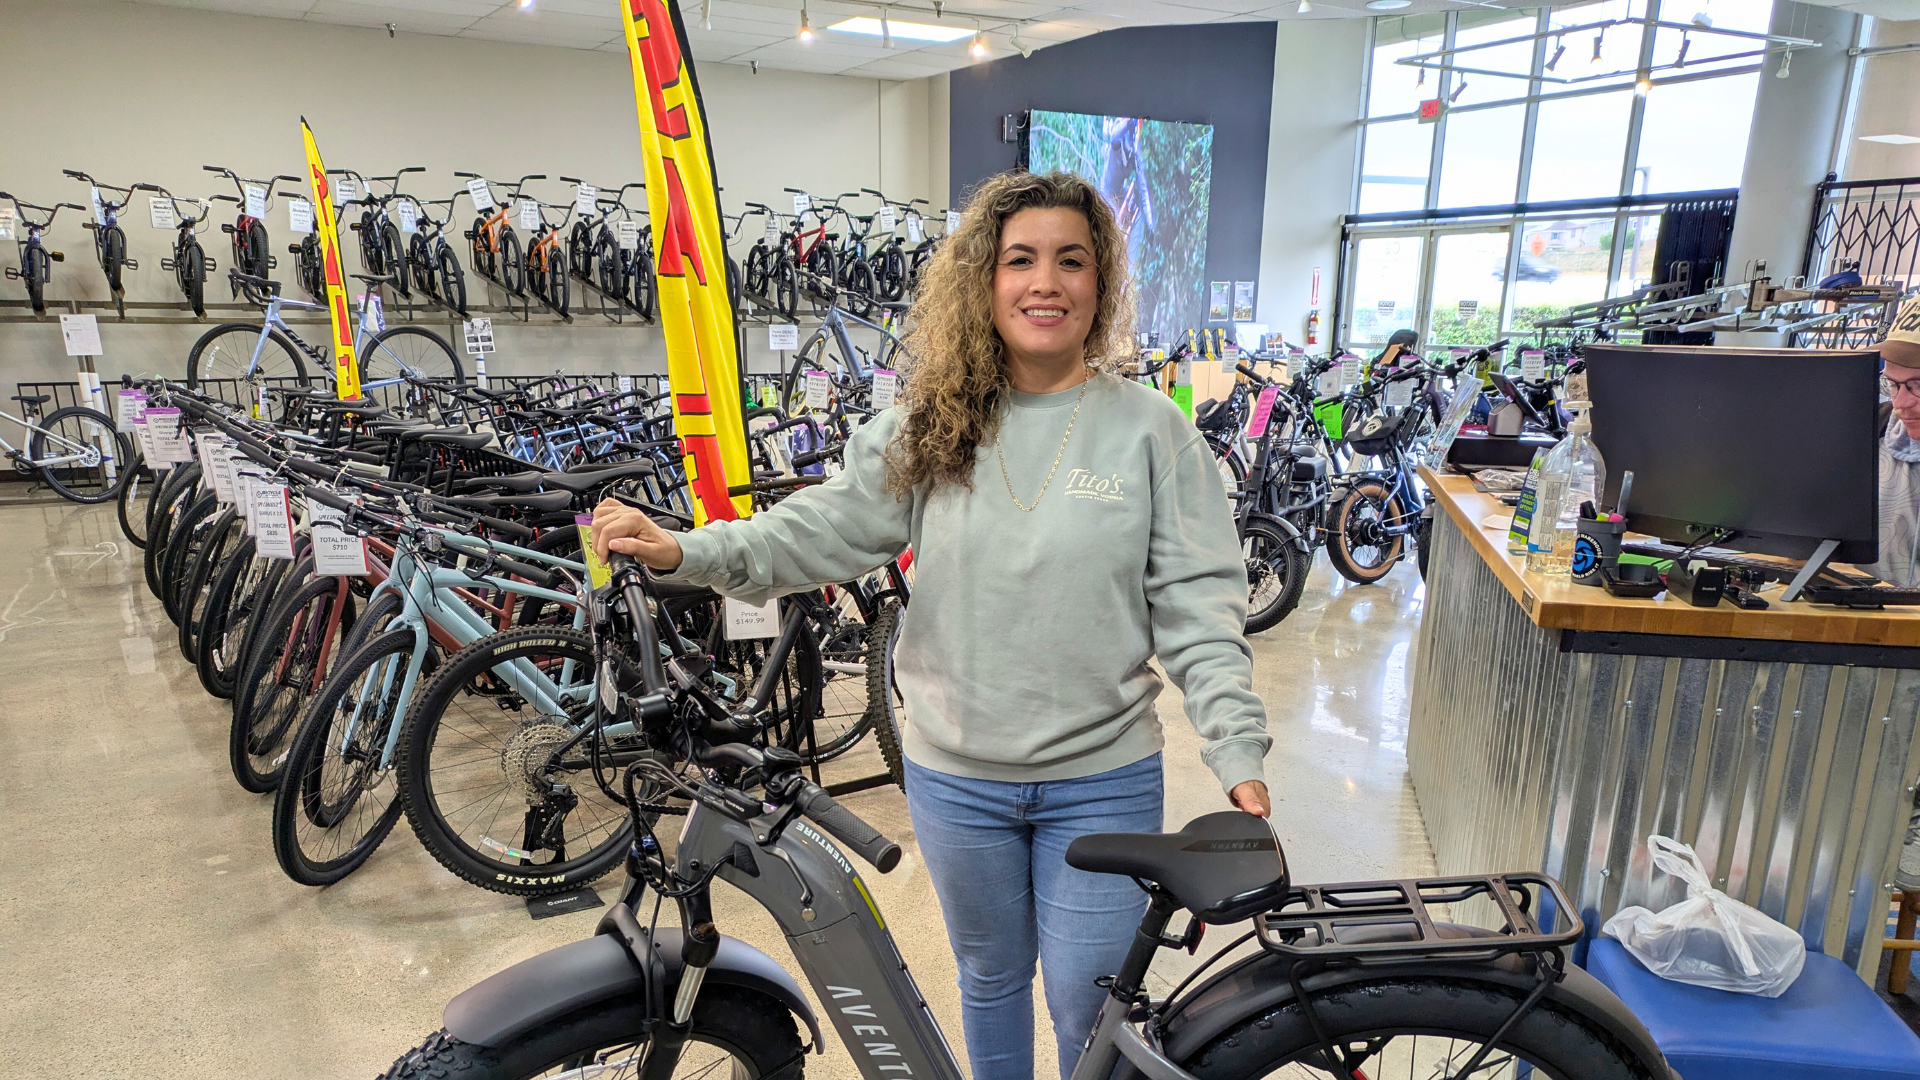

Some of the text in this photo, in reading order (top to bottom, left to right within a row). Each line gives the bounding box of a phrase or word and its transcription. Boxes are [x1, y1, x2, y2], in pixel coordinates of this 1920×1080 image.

[1422, 100, 1439, 117] EXIT
[1064, 489, 1099, 497] HANDMADE
[735, 617, 765, 625] $149.99
[493, 642, 517, 656] HIGH
[518, 639, 557, 649] ROLLER
[795, 821, 852, 874] AVENTURE
[1210, 841, 1260, 850] AVENTON
[496, 873, 566, 886] MAXXIS
[553, 896, 579, 905] GIANT
[826, 985, 914, 1080] AVENT
